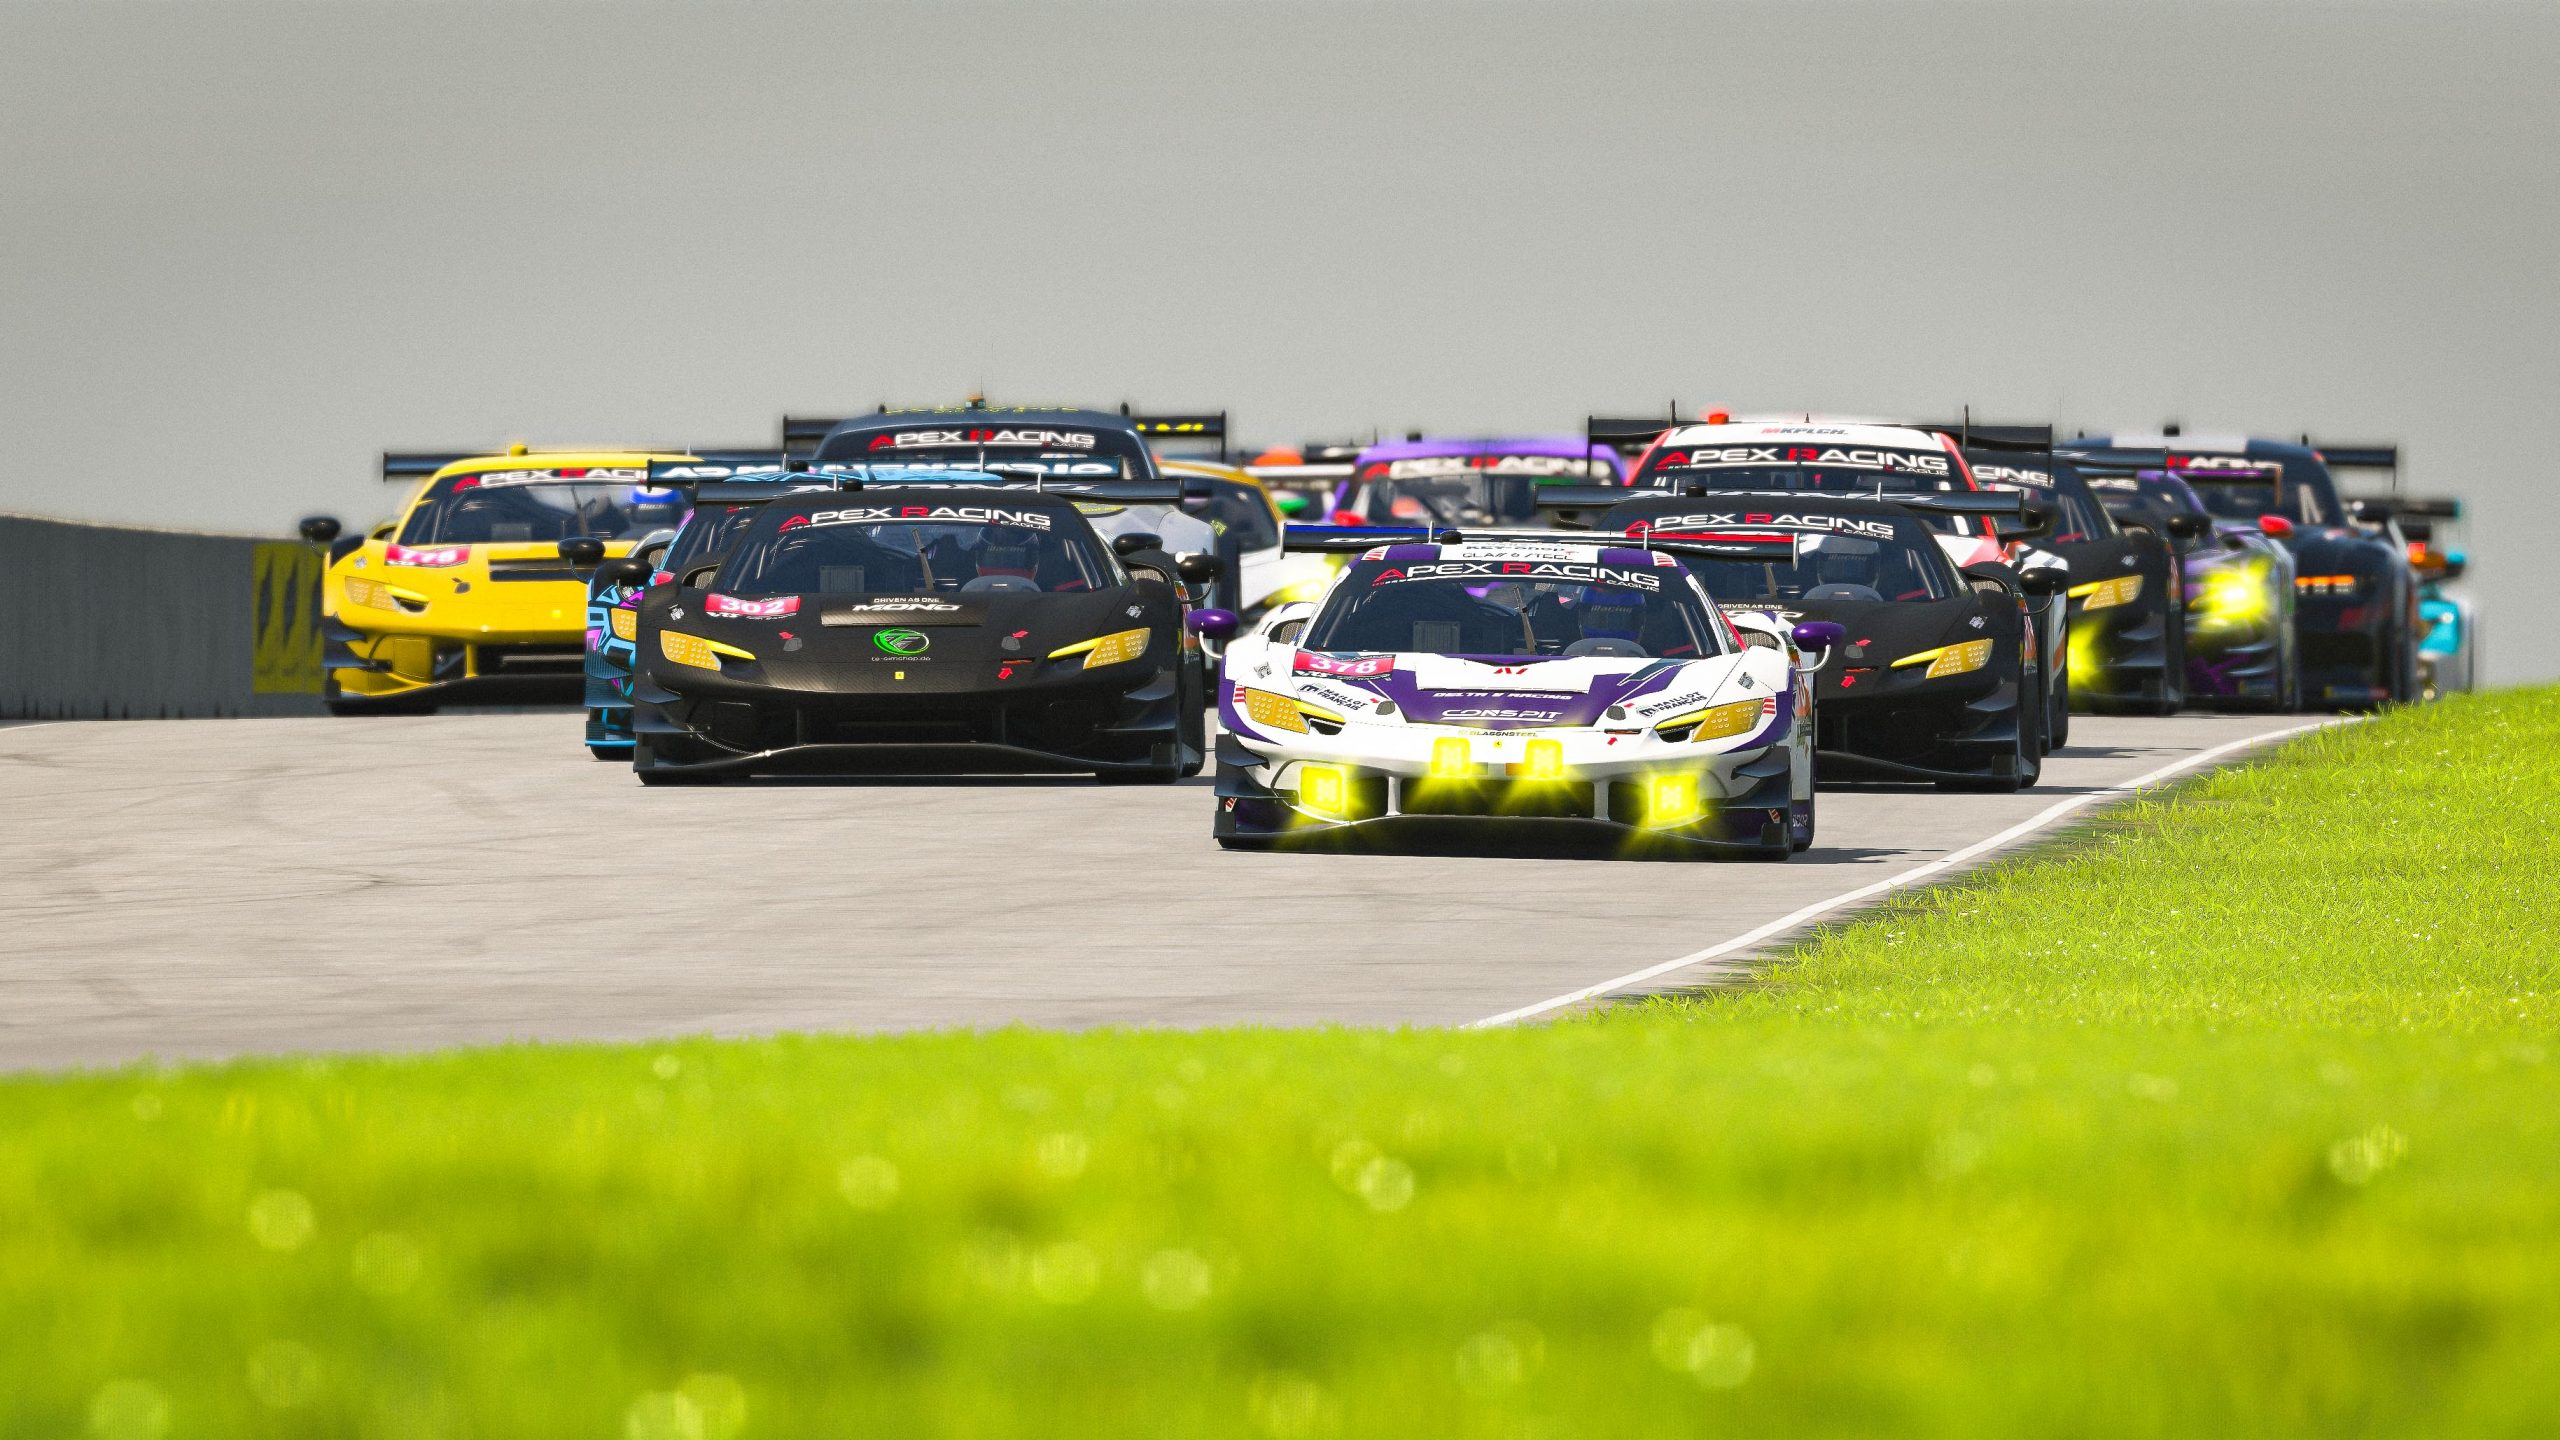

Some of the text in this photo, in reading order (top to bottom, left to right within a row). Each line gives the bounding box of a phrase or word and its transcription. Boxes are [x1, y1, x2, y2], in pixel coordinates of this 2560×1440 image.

[868, 429, 1095, 452] APEX RACING
[1654, 447, 1948, 471] APEX RACING
[778, 506, 1051, 533] APEX RACING
[990, 519, 1051, 532] LEAGUE
[1624, 512, 1894, 533] APEX RACING
[1371, 562, 1660, 587] APEX RACING
[1596, 578, 1660, 593] LEAGUE
[721, 598, 785, 614] 302
[1309, 657, 1377, 674] 378
[1323, 688, 1369, 708] MAILLOT
[1652, 691, 1702, 708] MAILLOT
[1659, 694, 1708, 711] FRANÇAIS
[1441, 709, 1564, 719] CONSPIT
